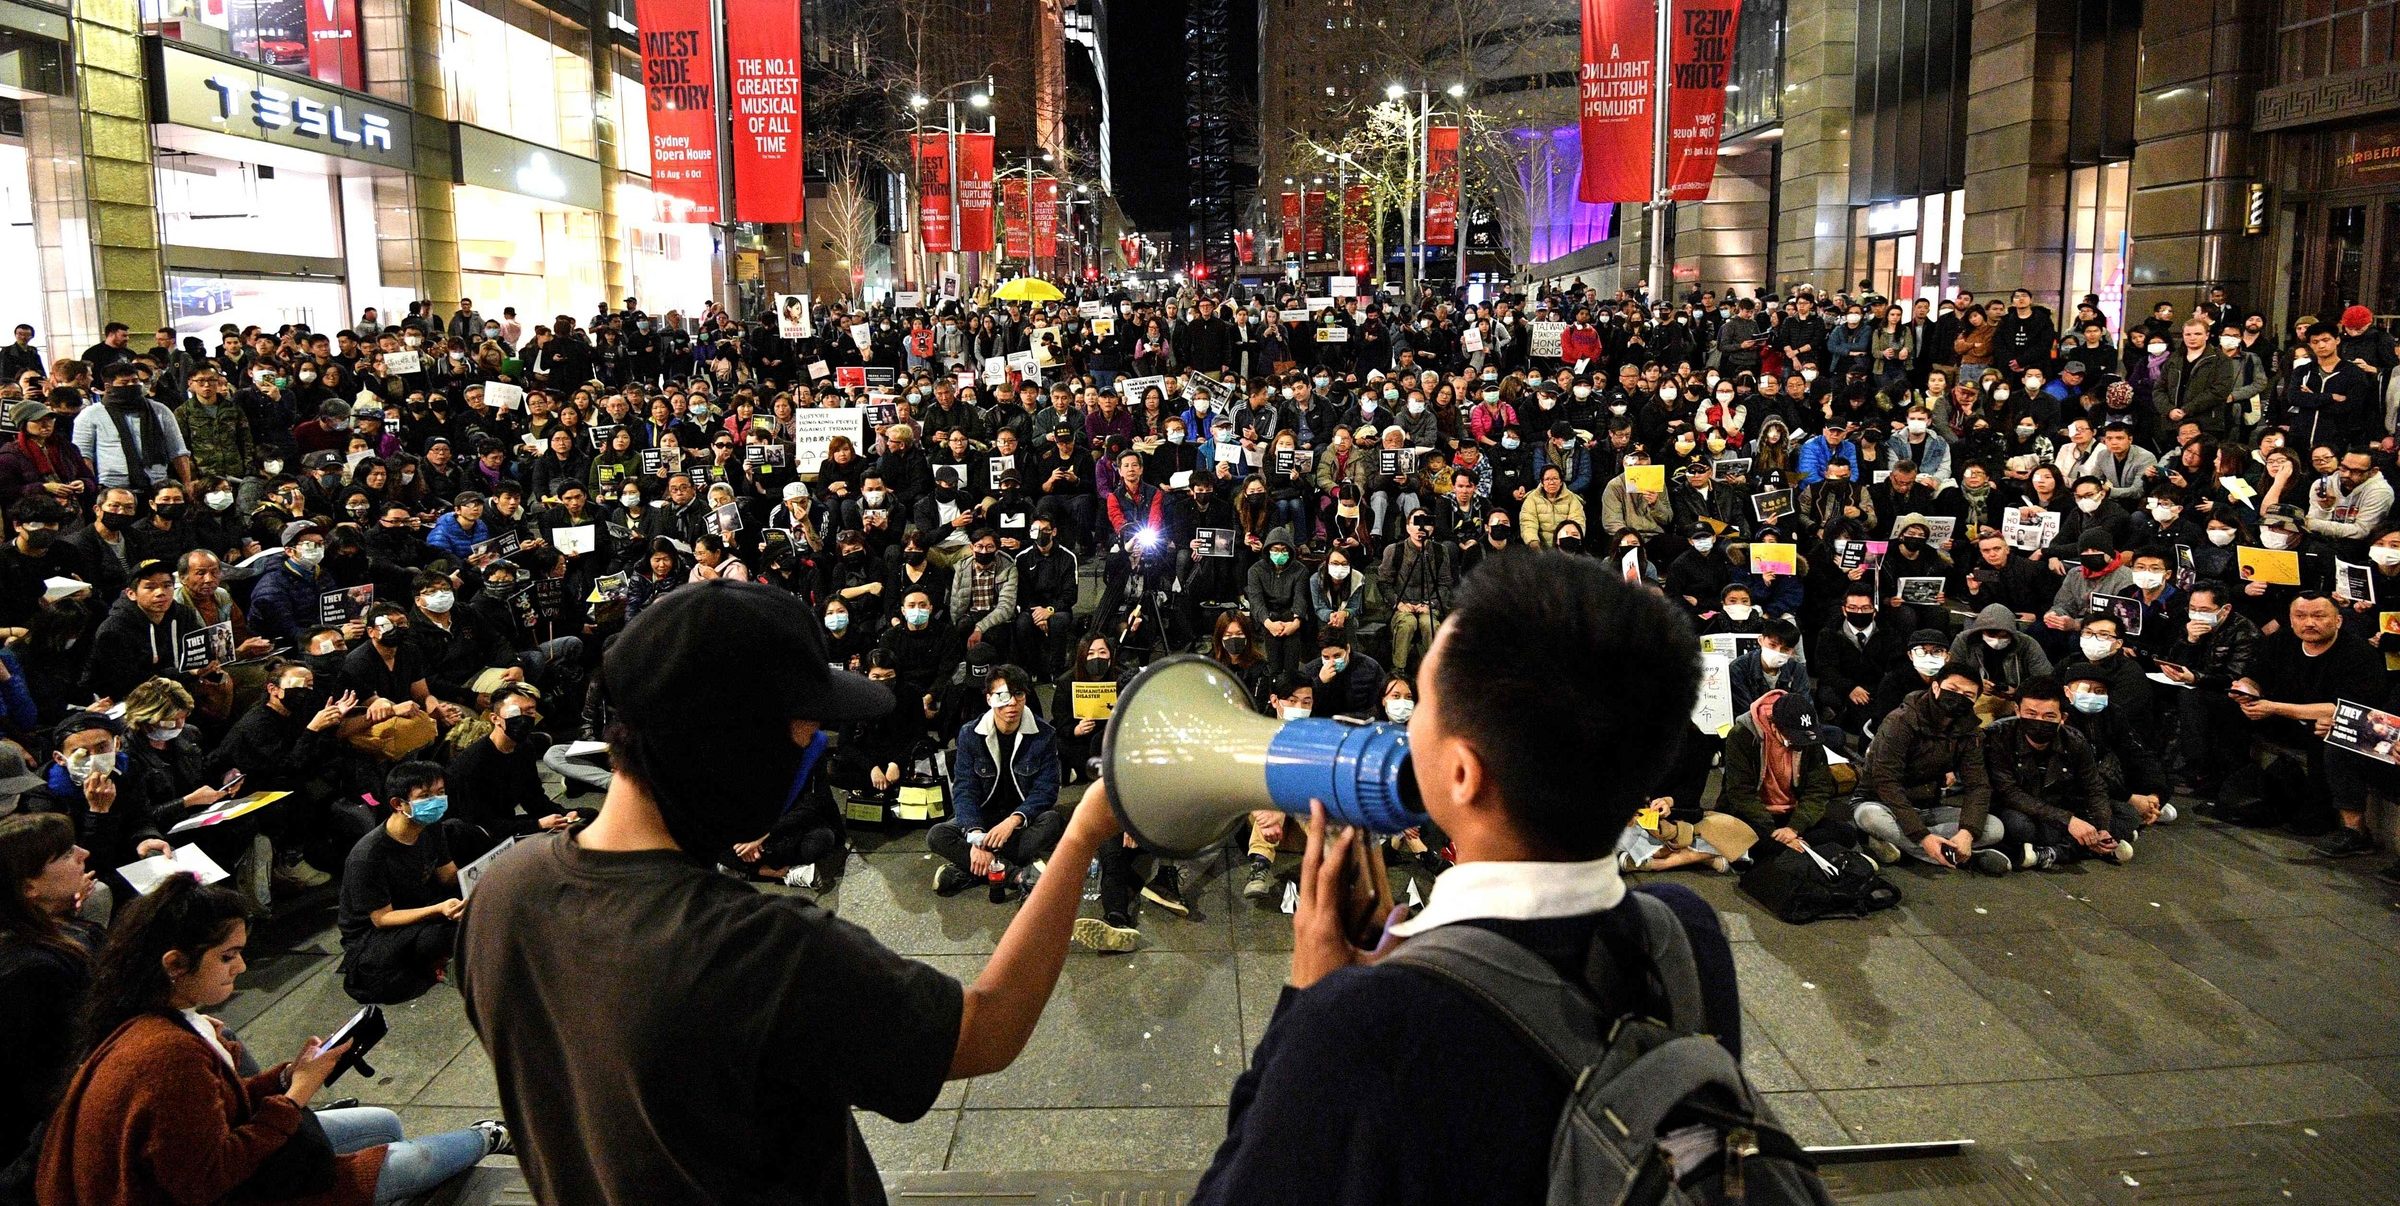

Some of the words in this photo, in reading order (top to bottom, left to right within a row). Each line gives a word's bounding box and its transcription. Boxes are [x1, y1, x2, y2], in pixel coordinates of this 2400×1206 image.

[312, 30, 352, 39] TESLA
[645, 30, 699, 58] WEST
[648, 58, 690, 85] SIDE
[737, 59, 762, 75] THE
[765, 58, 795, 75] NO.1
[737, 79, 798, 95] GREATEST
[651, 85, 709, 112] STORY
[741, 97, 797, 114] MUSICAL
[211, 75, 391, 150] TESLA
[748, 117, 765, 133] OF
[769, 117, 791, 133] ALL
[654, 135, 689, 149] Sydney
[754, 137, 787, 153] TIME
[655, 149, 685, 162] Opera
[686, 149, 712, 160] House
[656, 170, 666, 178] 16
[667, 170, 681, 179] Aug
[685, 170, 690, 178] 6
[691, 170, 702, 178] Oct
[973, 171, 978, 179] A
[960, 180, 992, 189] THRILLING
[960, 190, 992, 198] HURTLING
[961, 199, 991, 208] TRIUMPH
[1535, 323, 1566, 331] TAIWAN
[1532, 339, 1561, 347] HONG
[1532, 347, 1561, 355] KONG
[1848, 543, 1864, 551] THEY
[536, 581, 561, 592] FREE
[323, 593, 343, 604] THEY
[2093, 596, 2109, 607] THEY
[185, 635, 205, 648] THEY
[2340, 704, 2362, 720] THEY
